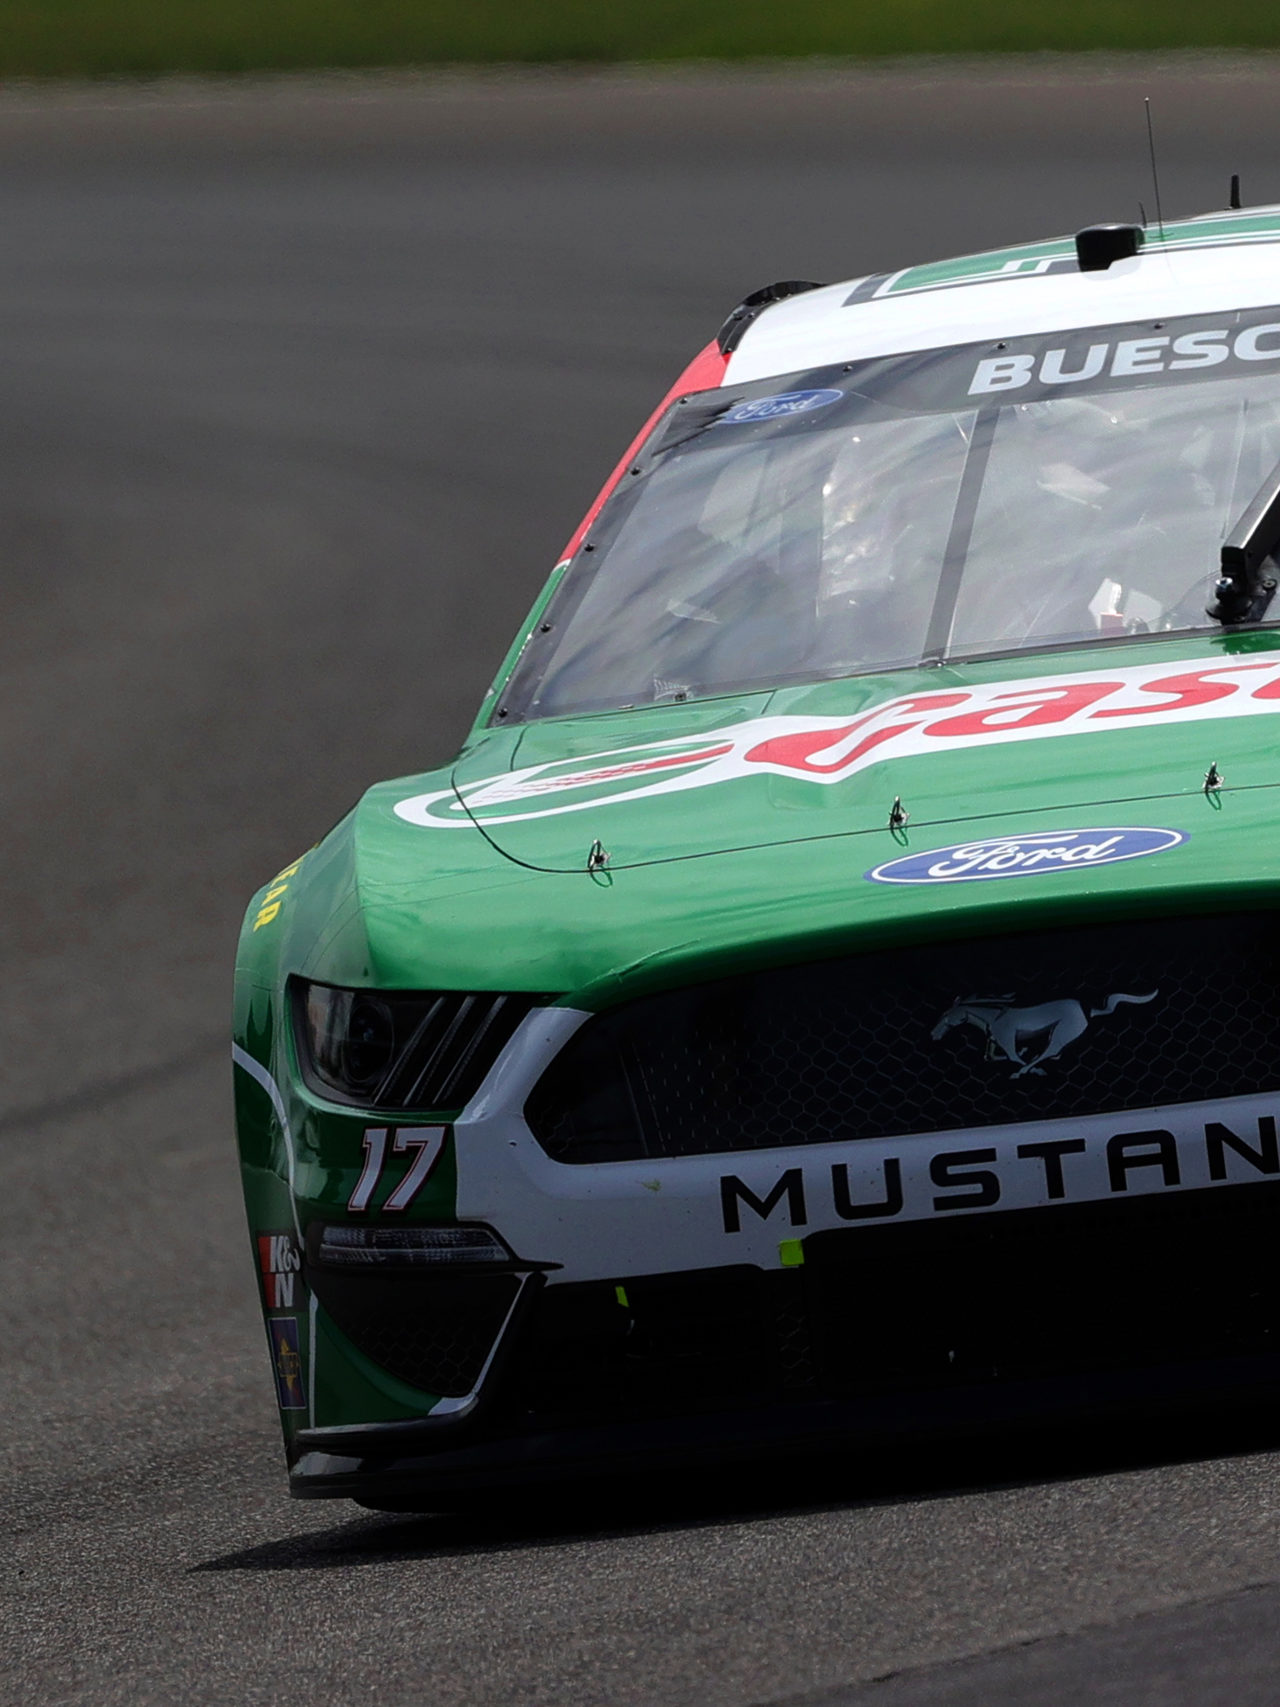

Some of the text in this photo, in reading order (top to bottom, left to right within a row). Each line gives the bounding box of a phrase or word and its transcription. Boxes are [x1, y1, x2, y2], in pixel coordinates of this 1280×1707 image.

[733, 393, 820, 420] Ford
[927, 833, 1126, 878] Ford
[347, 1125, 447, 1212] 17
